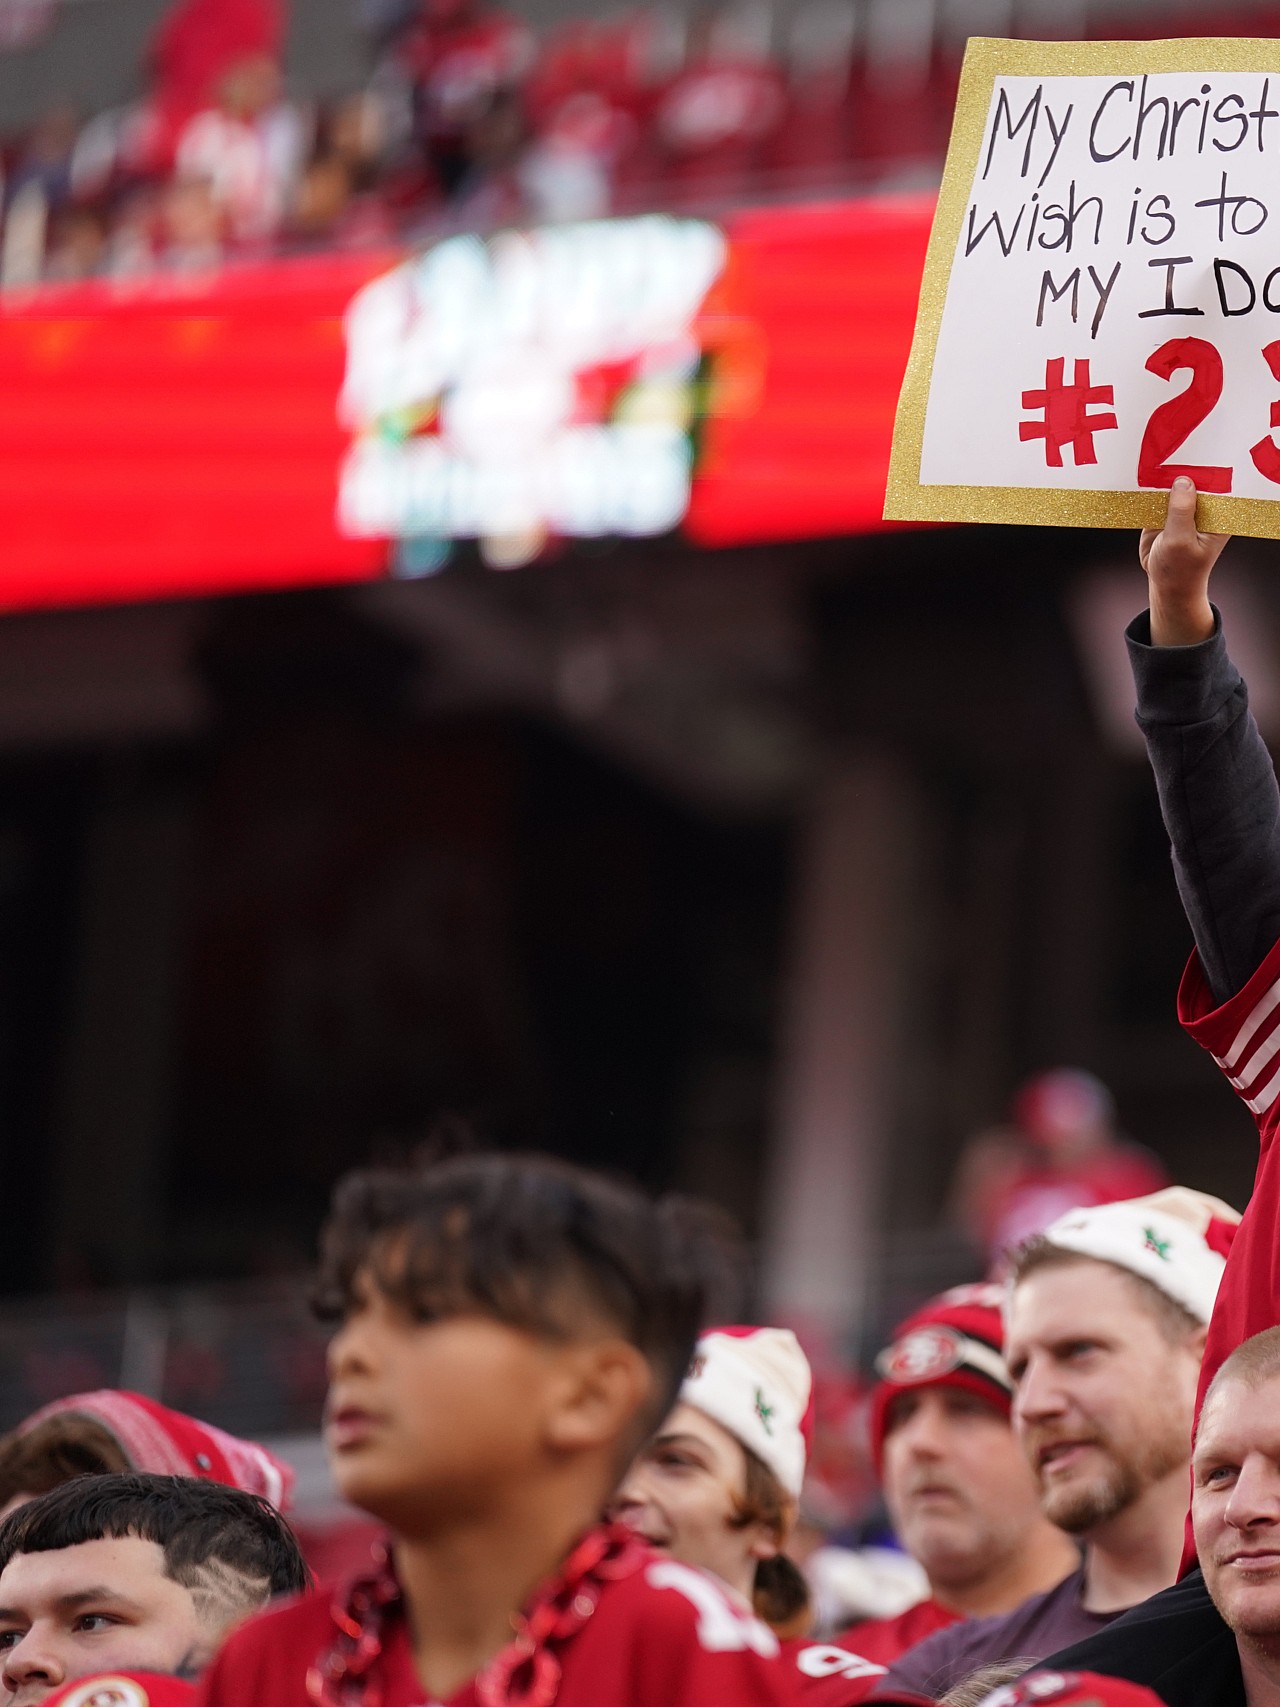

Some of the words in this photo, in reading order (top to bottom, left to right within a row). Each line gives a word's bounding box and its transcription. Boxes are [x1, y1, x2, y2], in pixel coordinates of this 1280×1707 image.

[982, 84, 1074, 189] My
[1126, 186, 1176, 246] is
[1194, 170, 1269, 243] to
